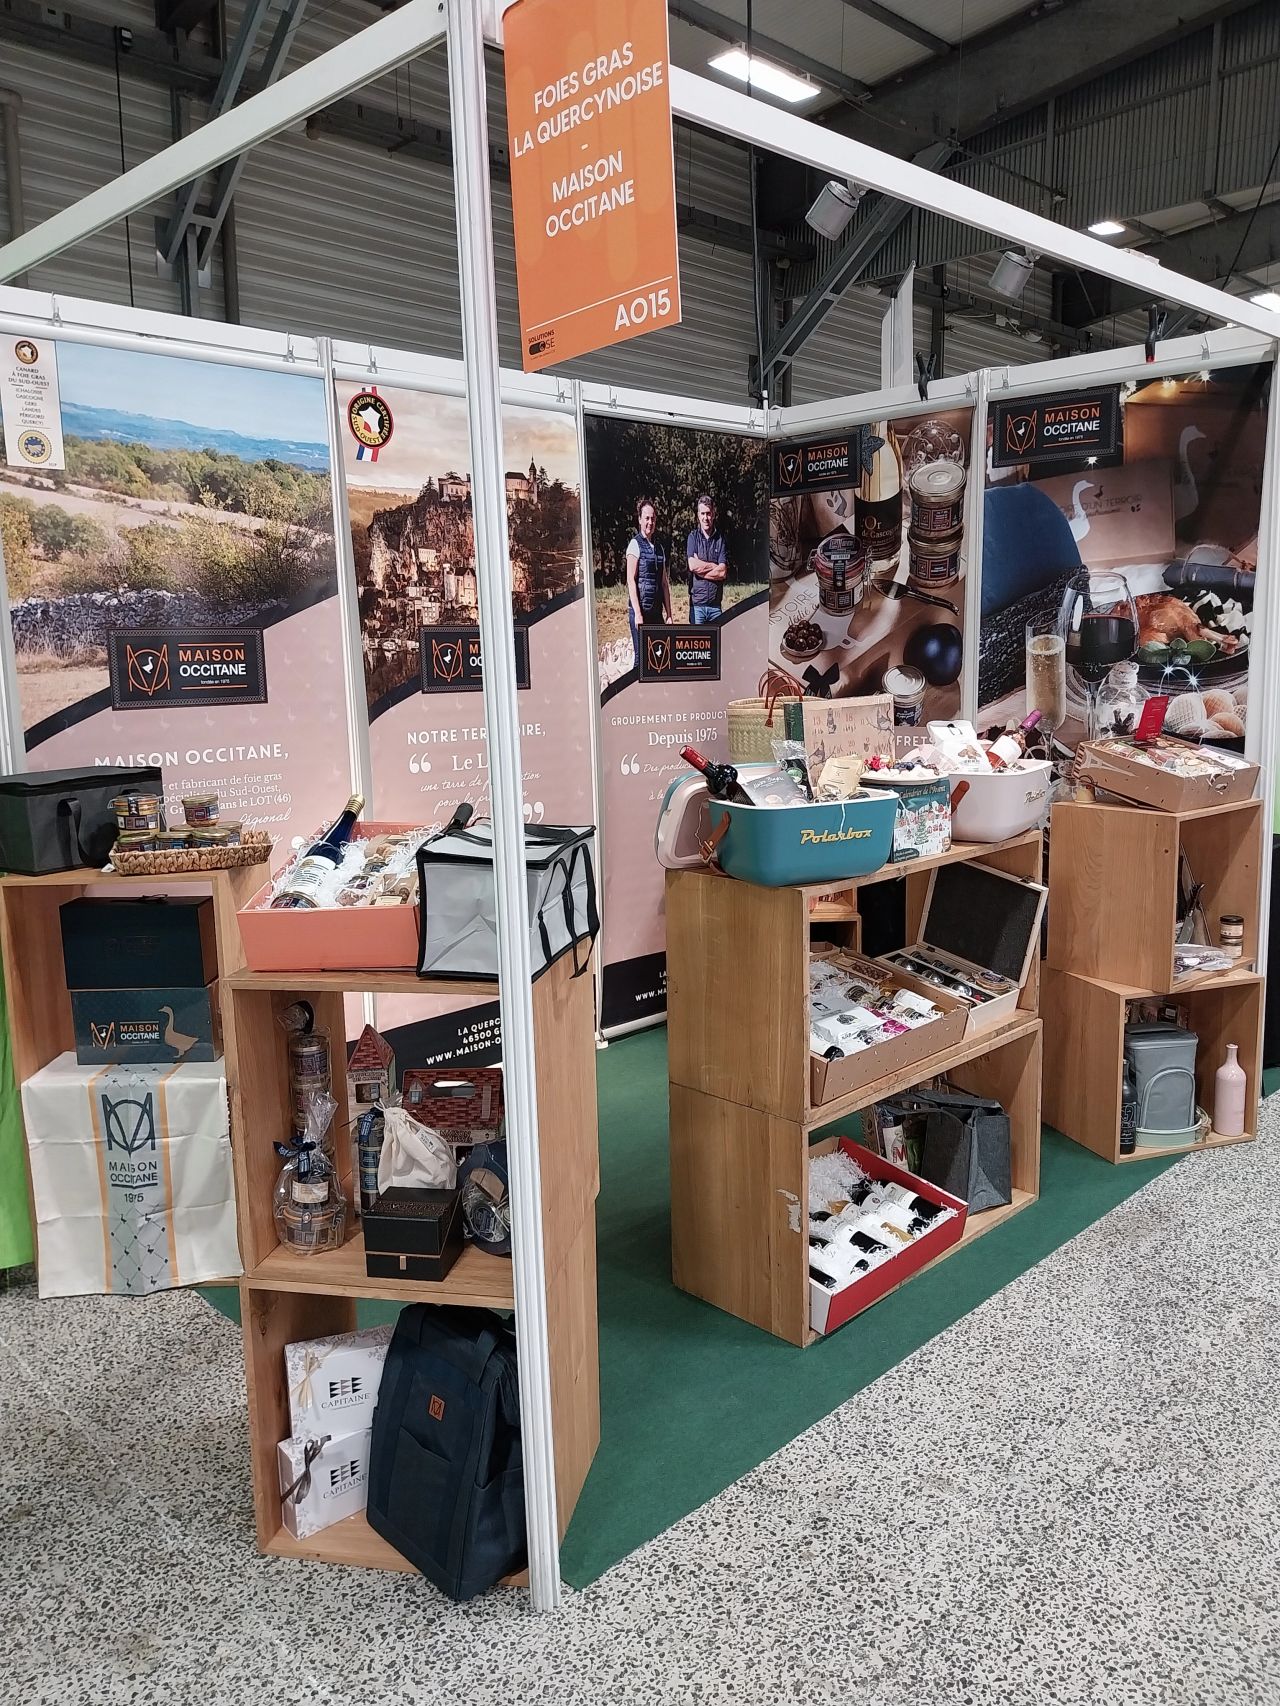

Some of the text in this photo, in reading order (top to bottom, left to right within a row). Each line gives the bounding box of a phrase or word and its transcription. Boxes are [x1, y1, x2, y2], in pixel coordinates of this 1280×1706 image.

[534, 42, 634, 114] FOIES GRAS
[514, 61, 663, 158] LA QUERCYNOISE
[552, 150, 623, 203] MAISON
[545, 180, 635, 238] OCCITANE
[528, 329, 555, 344] SOLUTIONS
[352, 396, 376, 414] ORIGINE
[1045, 407, 1100, 423] MAISON
[1043, 419, 1100, 437] OCCITANE
[807, 446, 848, 460] MAISON
[807, 457, 849, 472] OCCITANE
[676, 640, 711, 650] MAISON
[178, 649, 245, 662] MAISON
[676, 651, 711, 660] OCCITANE
[179, 663, 247, 677] OCCITANE
[611, 711, 728, 726] GROUPEMENT DE PRODUCT
[407, 729, 458, 745] NOTRE
[648, 728, 717, 748] Depuis 1975
[95, 743, 289, 767] MAISON OCCITANE,
[451, 755, 473, 771] Le
[181, 778, 228, 789] fabricant
[230, 776, 241, 785] de
[244, 774, 262, 784] foie
[264, 772, 283, 783] gras
[420, 783, 439, 792] une
[442, 780, 467, 790] terre
[469, 774, 482, 787] de
[214, 789, 227, 798] du
[229, 784, 281, 796] Sud-Ouest,
[239, 799, 248, 807] le
[250, 795, 272, 806] LOT
[274, 793, 292, 805] (46)
[434, 797, 461, 815] pour
[801, 828, 872, 844] Polarbox
[120, 1024, 159, 1032] MAISON
[120, 1032, 160, 1040] OCCITANE
[458, 1025, 469, 1036] LA
[462, 1029, 492, 1045] 46500
[426, 1036, 501, 1065] WWW.MAISON-O
[109, 1161, 157, 1173] MAISON
[110, 1172, 158, 1184] OCCITANE
[321, 1392, 370, 1409] CAPITAINE
[323, 1472, 368, 1499] CAPITAINE
